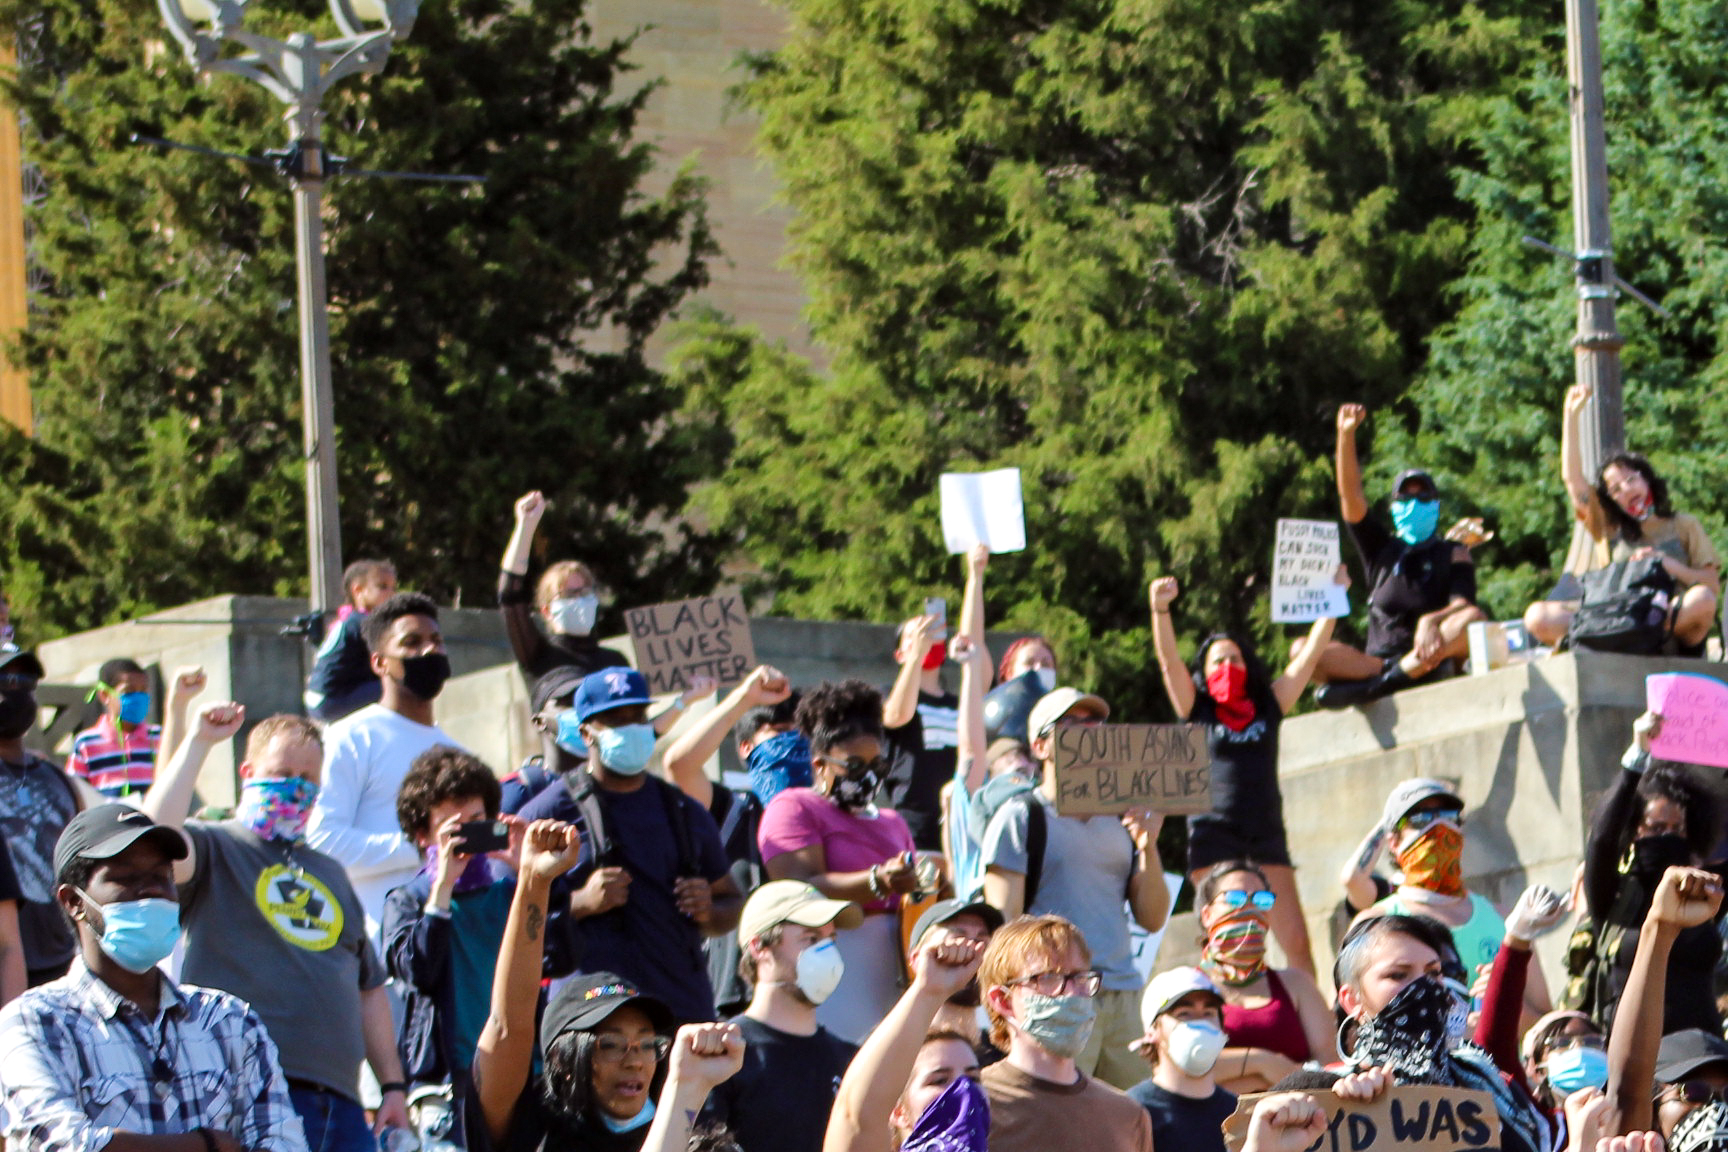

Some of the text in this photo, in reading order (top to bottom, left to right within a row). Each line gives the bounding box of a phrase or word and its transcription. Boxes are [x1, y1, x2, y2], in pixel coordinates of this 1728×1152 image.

[1281, 601, 1331, 615] MATTER
[1297, 589, 1326, 600] LIVES
[629, 597, 744, 639] BLACK
[646, 630, 732, 665] LIVES
[645, 655, 750, 692] MATTER
[1058, 726, 1130, 770] SOUTH
[1141, 726, 1197, 763] ASIANS
[1096, 766, 1159, 801] BLACK
[1162, 763, 1209, 797] LIVES
[1391, 1098, 1490, 1146] WAS
